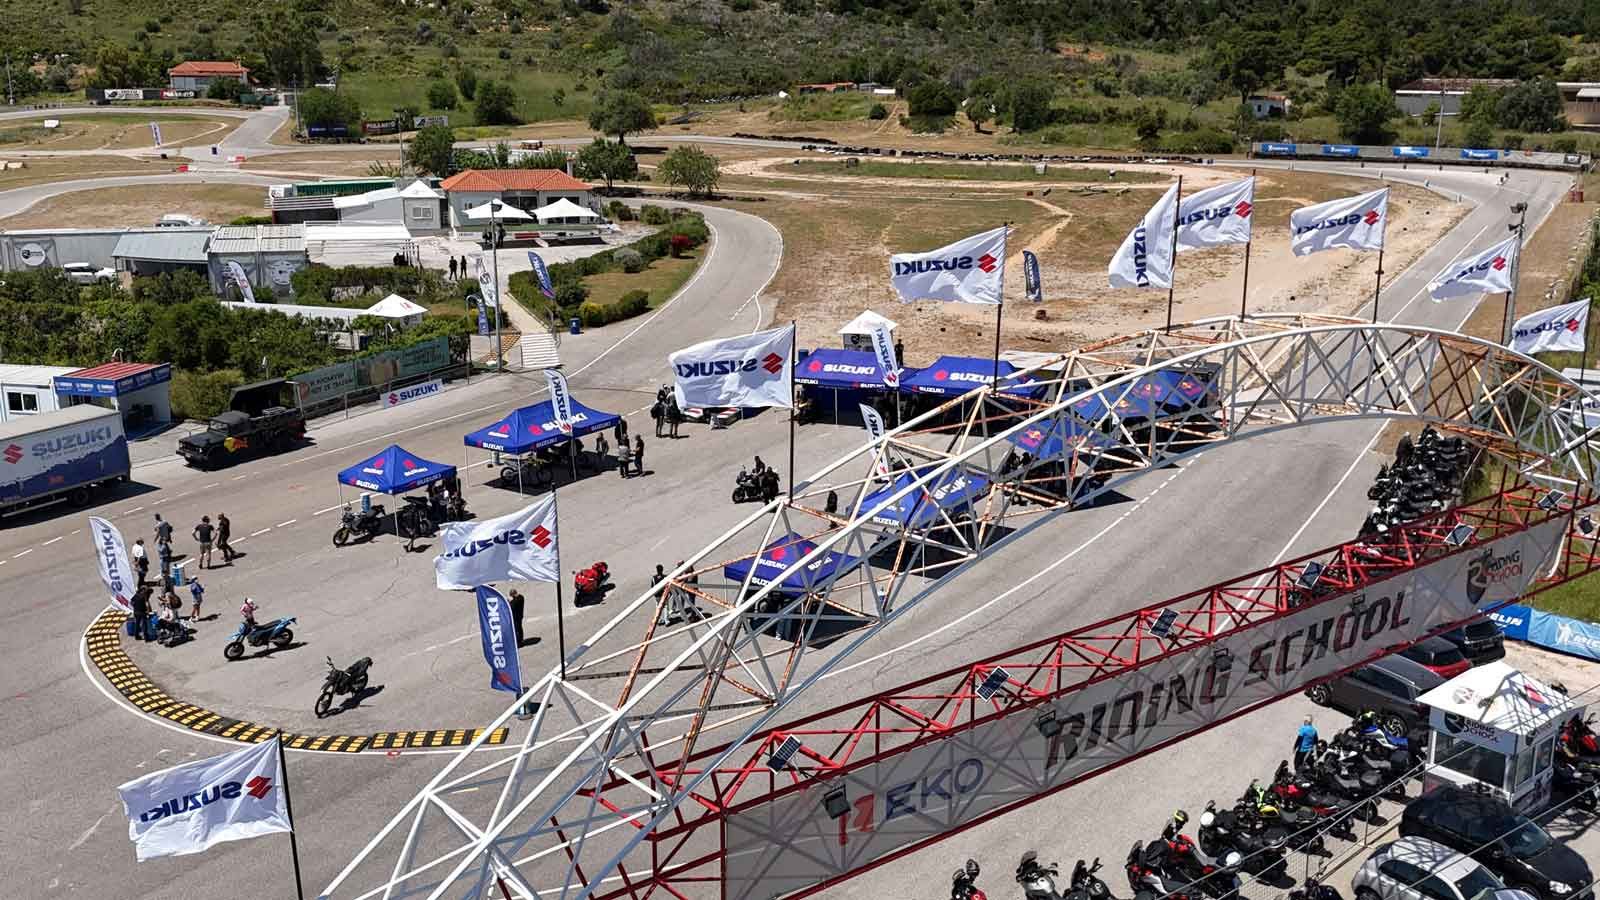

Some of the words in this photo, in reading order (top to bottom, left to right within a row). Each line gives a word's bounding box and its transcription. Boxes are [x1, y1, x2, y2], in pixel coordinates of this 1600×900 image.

[823, 364, 876, 375] SUZUKI
[400, 383, 438, 401] SUZUKI
[32, 426, 112, 456] SUZUKI
[886, 758, 984, 820] EKO
[1046, 661, 1232, 769] RIDING
[1244, 592, 1410, 686] SCHOOL
